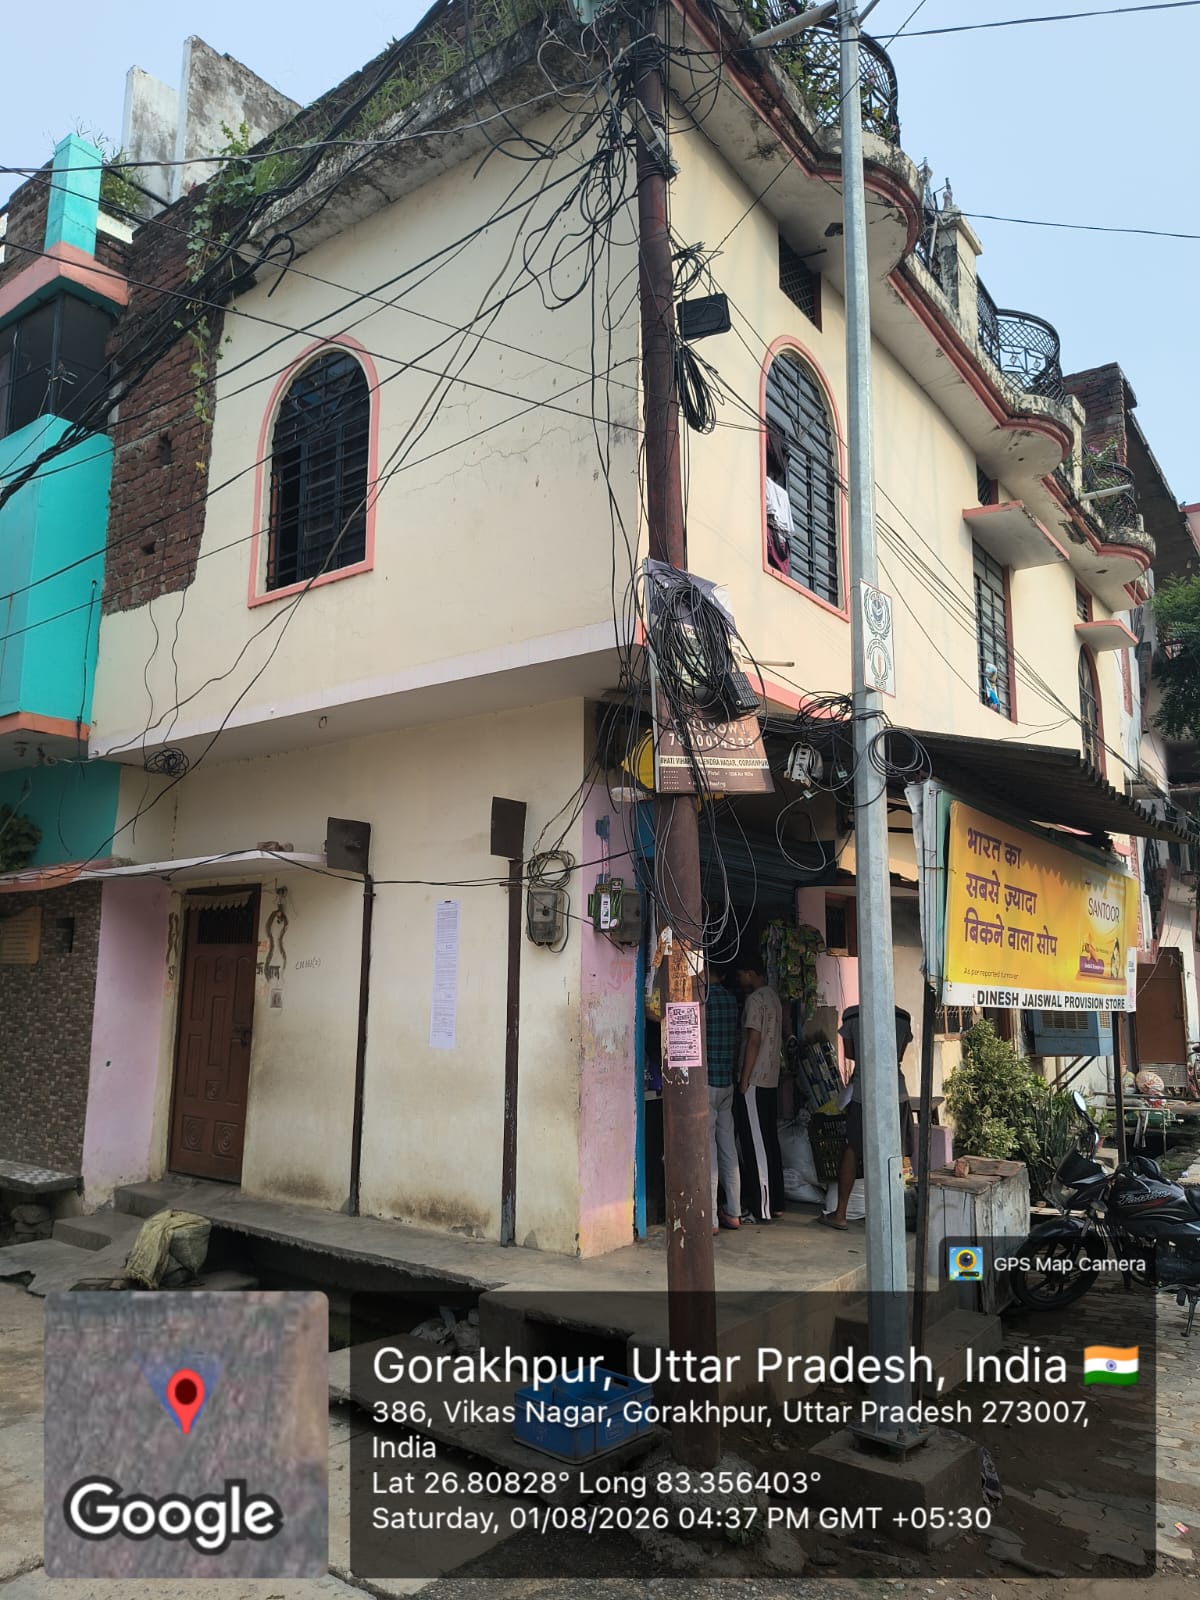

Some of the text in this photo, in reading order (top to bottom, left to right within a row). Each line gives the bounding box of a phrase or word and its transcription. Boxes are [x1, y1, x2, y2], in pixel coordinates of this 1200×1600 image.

[967, 827, 1022, 869] भारत का
[966, 870, 1001, 904] सबसे
[1088, 897, 1120, 923] SANTOOR
[964, 907, 1058, 957] बिकने वाला सोप
[977, 989, 1125, 1010] DINESH JAISWAL PROVISION STORE
